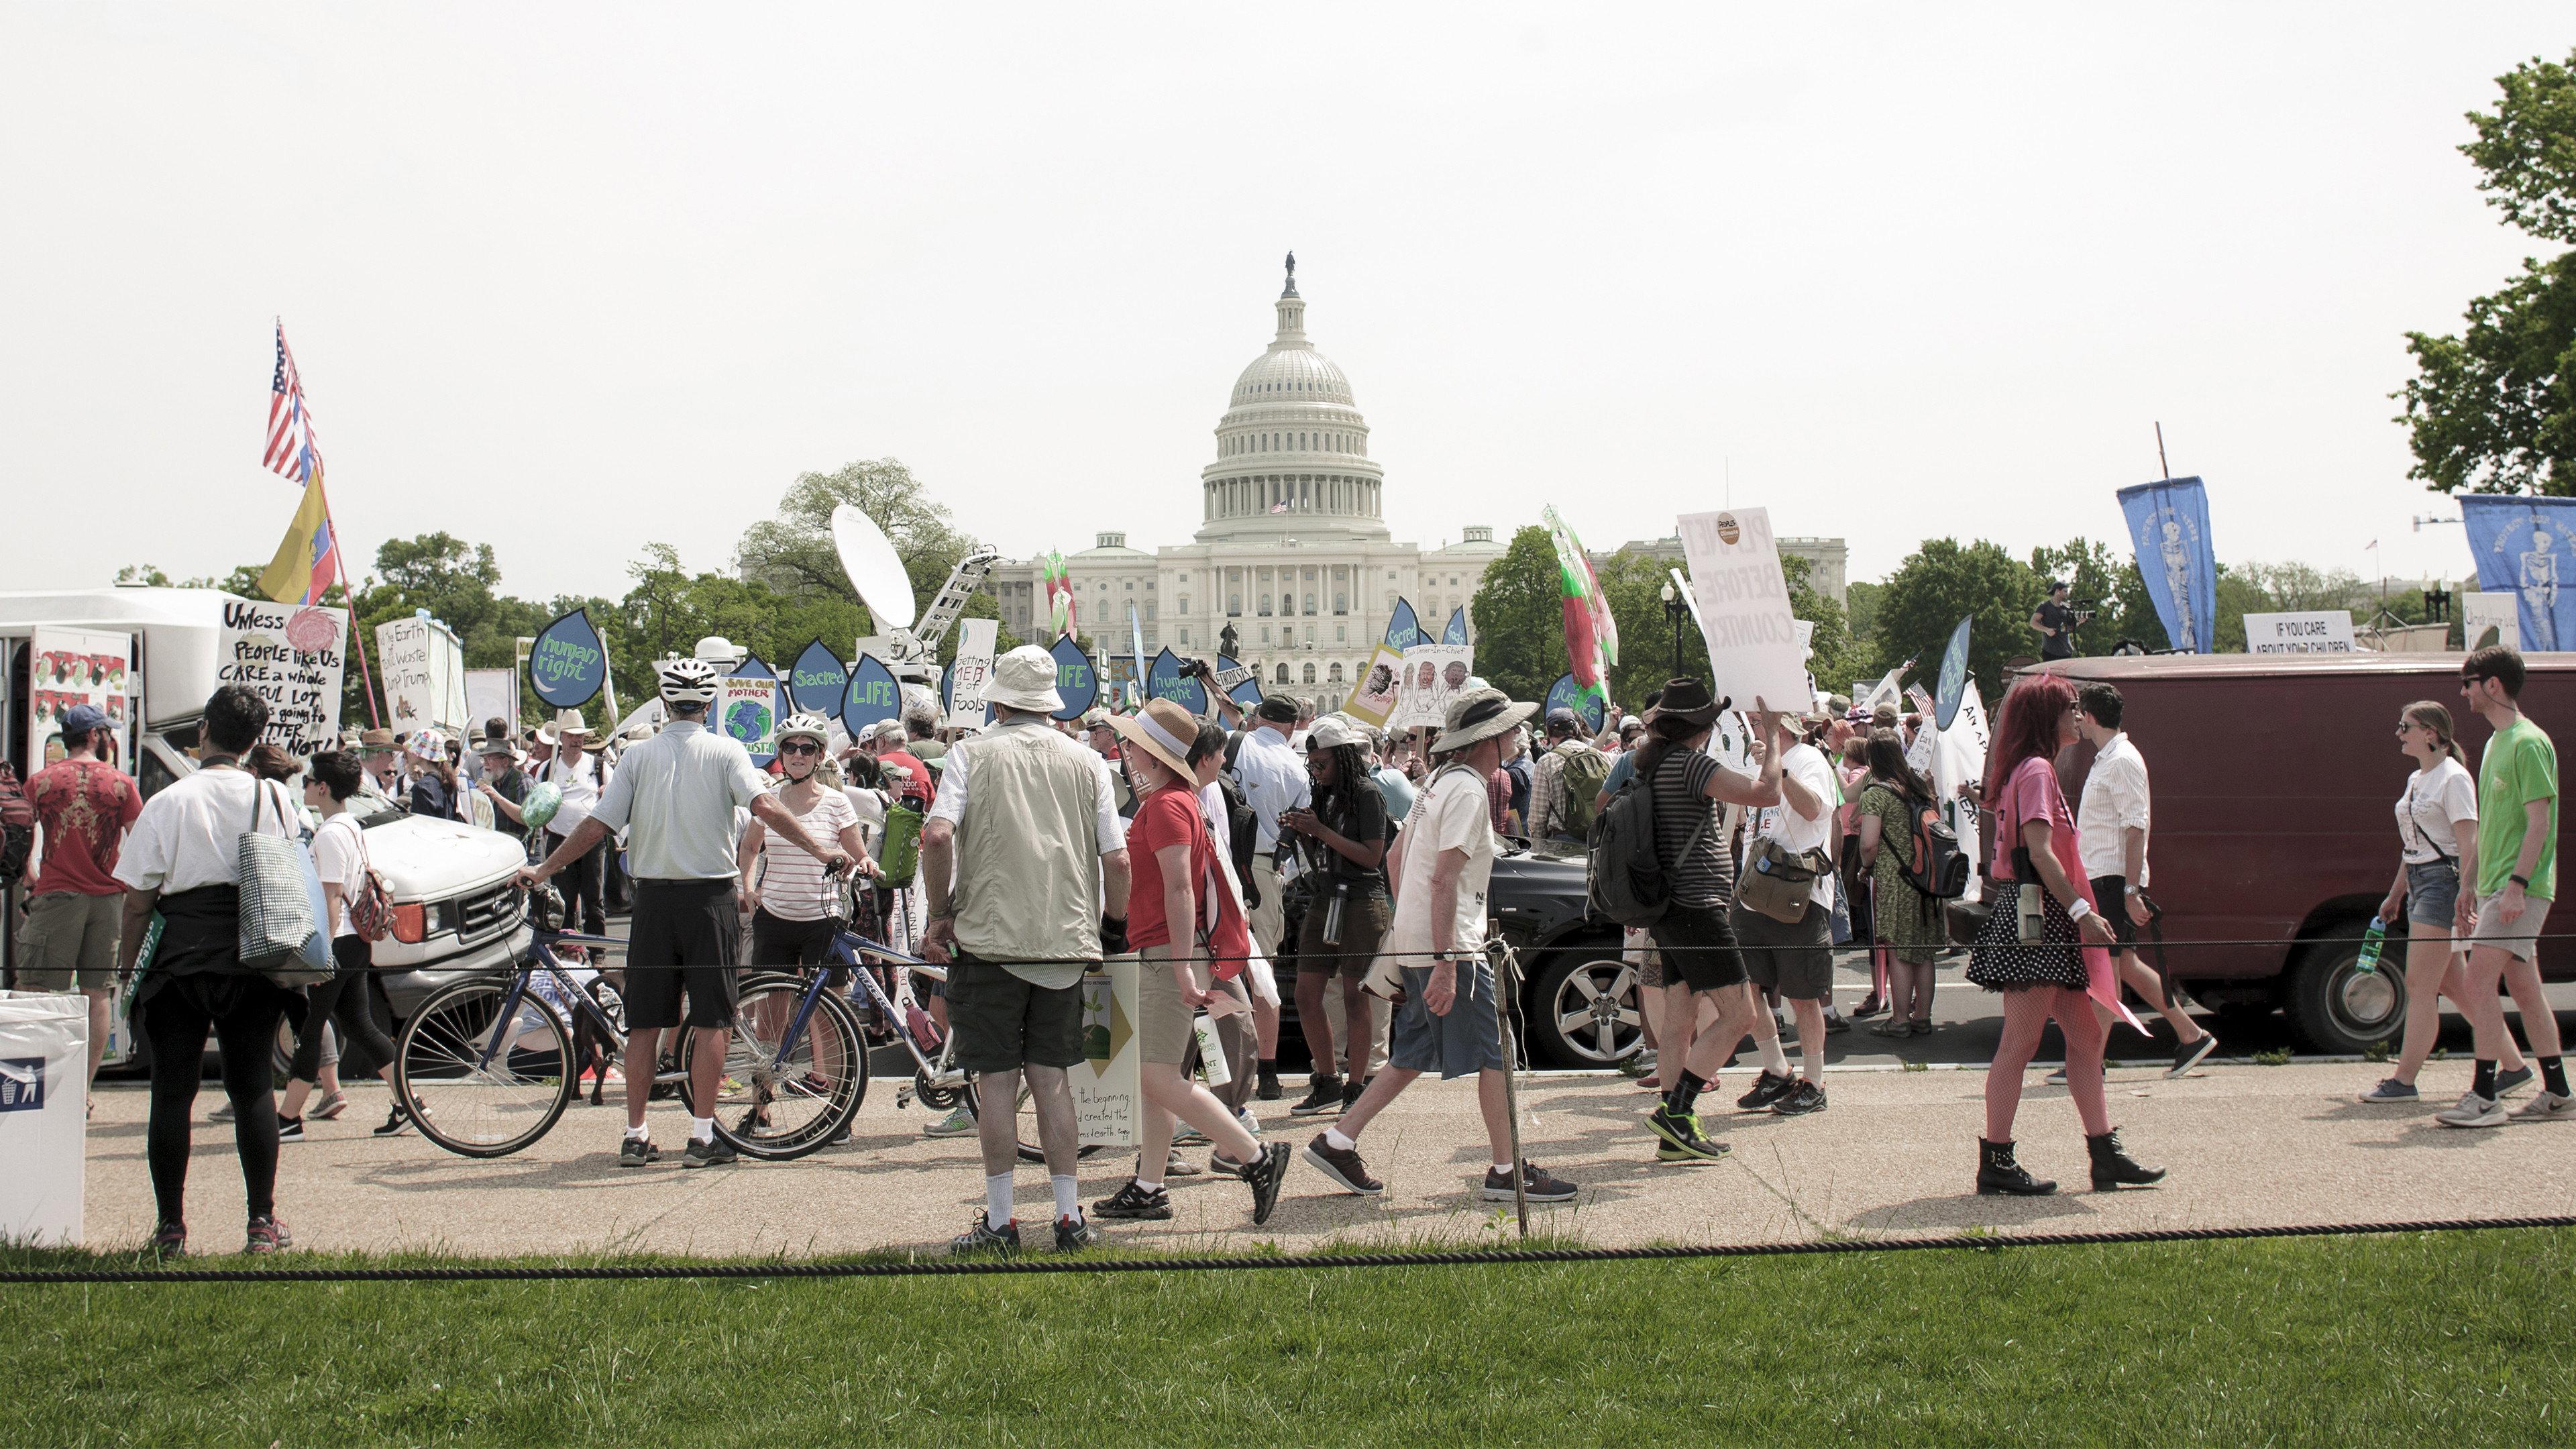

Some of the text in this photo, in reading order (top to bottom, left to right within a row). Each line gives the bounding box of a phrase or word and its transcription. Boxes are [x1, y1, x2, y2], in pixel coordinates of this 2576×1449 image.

[223, 602, 284, 630] Unless
[394, 621, 425, 642] Earth
[2275, 621, 2327, 637] IF YOU CARE
[235, 641, 340, 668] PEOPLE like Us
[395, 648, 427, 665] Waste
[542, 633, 599, 665] human
[219, 664, 327, 686] CARE a whole
[537, 655, 586, 681] right
[1058, 664, 1087, 688] IFE
[725, 678, 775, 690] SAVE OUR
[794, 669, 845, 688] Sacred
[966, 679, 981, 690] of
[727, 688, 769, 699] MOTHER
[853, 680, 893, 706] LIFE
[952, 693, 986, 714] Fools
[279, 708, 310, 724] going
[311, 708, 327, 723] to
[286, 737, 333, 757] NOT!
[857, 968, 890, 1010] TREK
[1079, 1087, 1091, 1104] the
[1084, 1110, 1113, 1122] created
[1114, 1108, 1128, 1121] the
